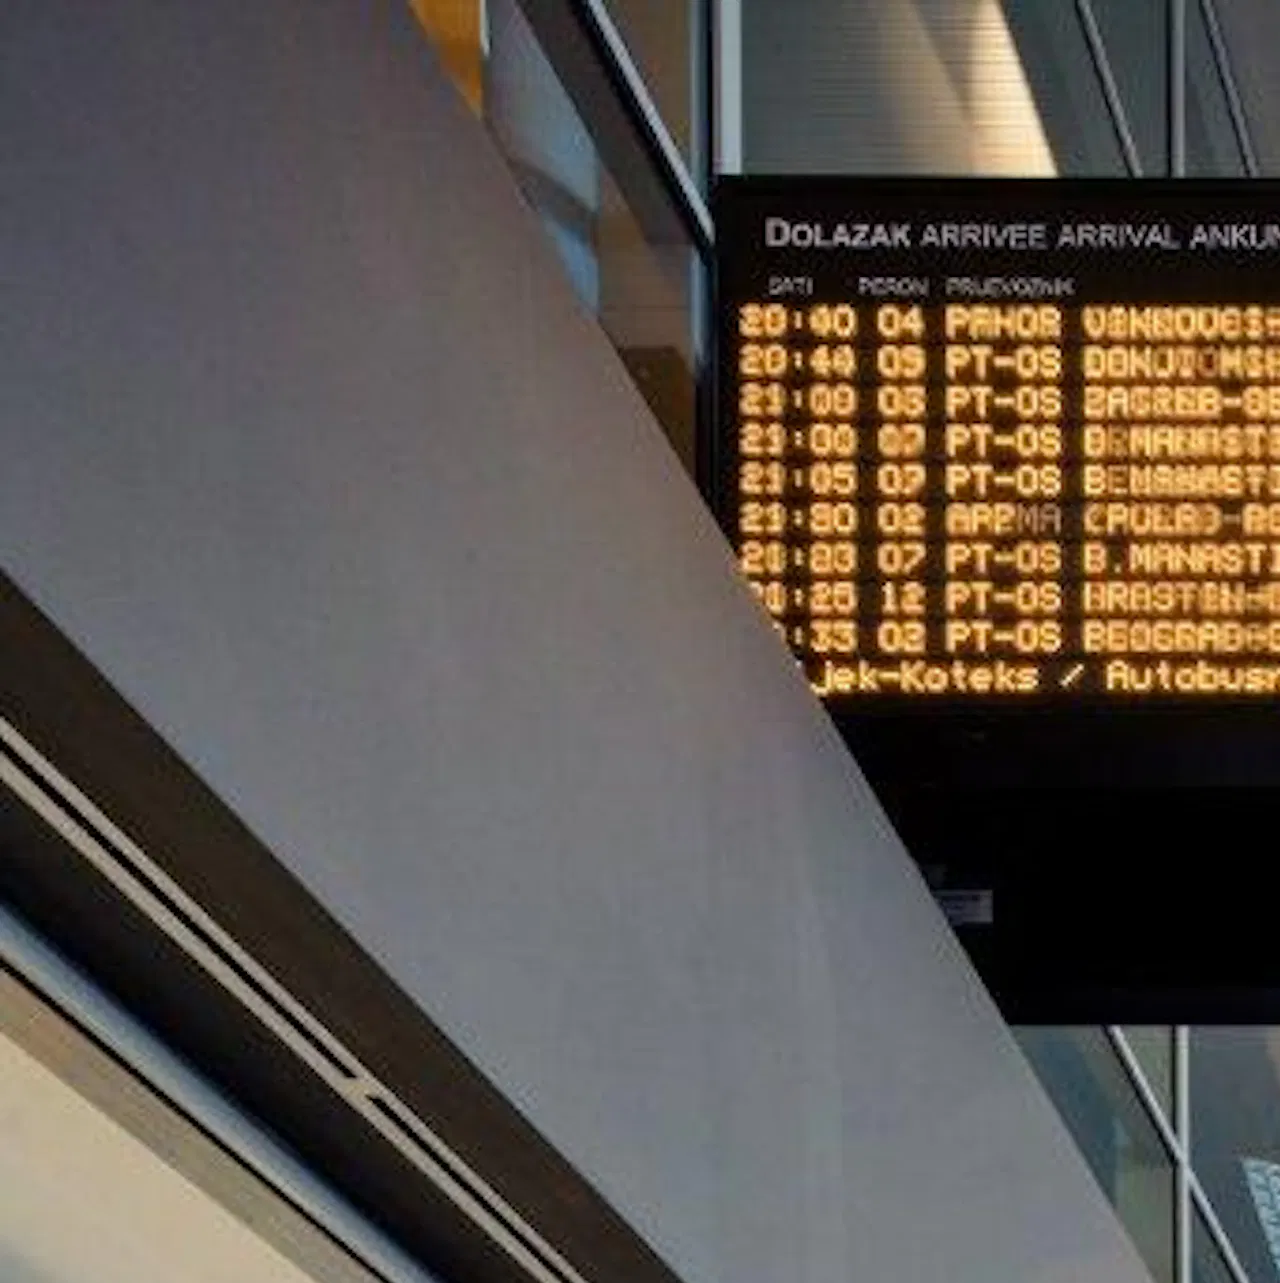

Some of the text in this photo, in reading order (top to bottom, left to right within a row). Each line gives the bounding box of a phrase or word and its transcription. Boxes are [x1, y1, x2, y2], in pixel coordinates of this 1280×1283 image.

[765, 217, 911, 248] DOLAZAK
[921, 223, 1047, 249] ARRIVEE
[1057, 224, 1178, 250] ARRIVAL
